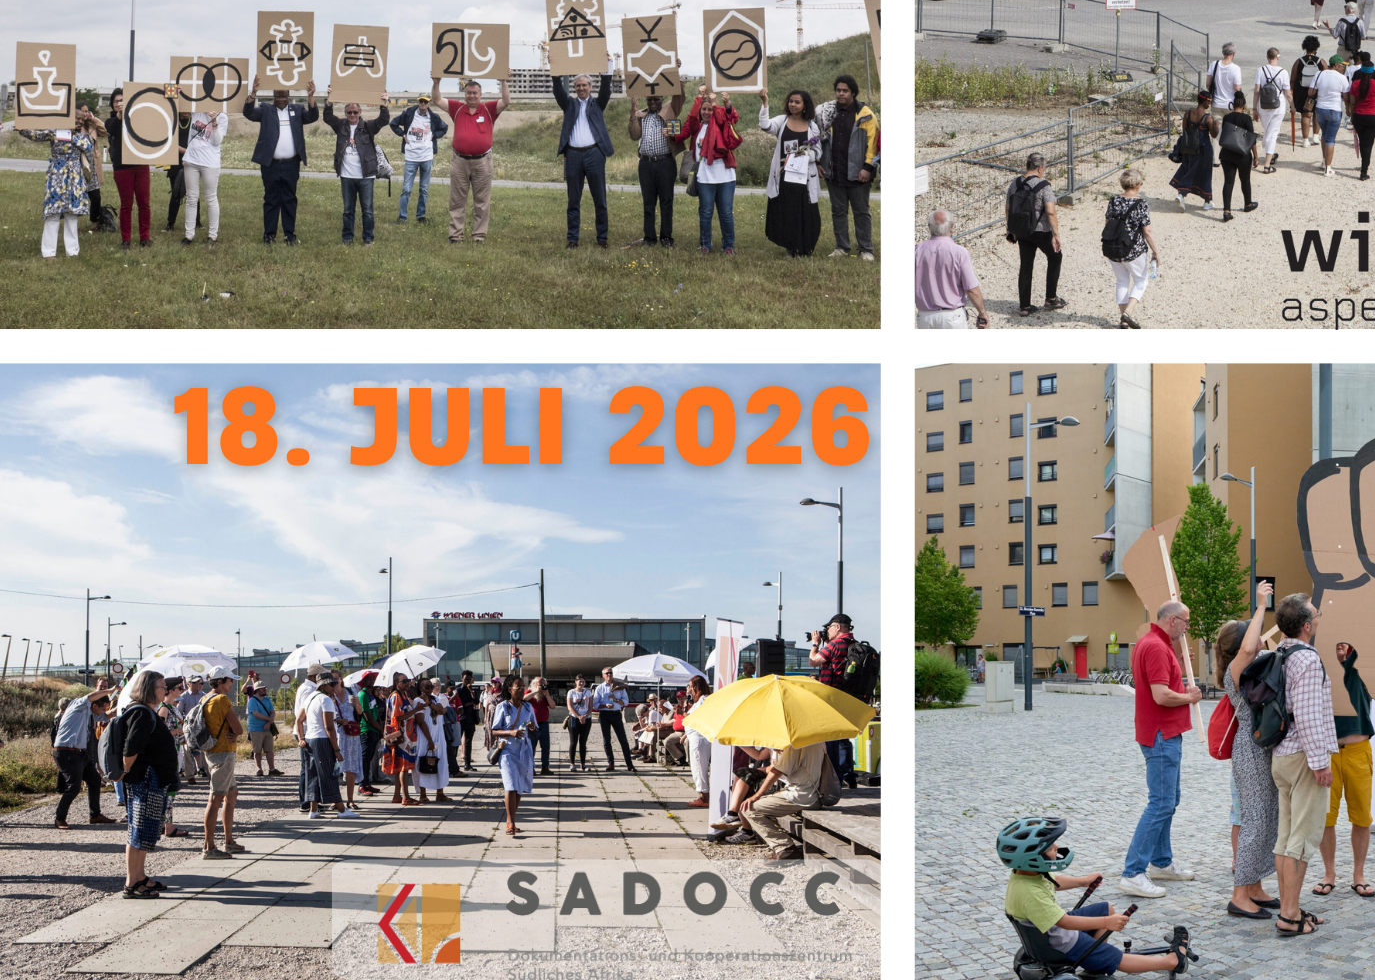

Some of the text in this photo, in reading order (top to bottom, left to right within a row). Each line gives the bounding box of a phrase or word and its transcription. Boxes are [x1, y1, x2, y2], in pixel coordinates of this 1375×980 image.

[443, 611, 503, 619] WIENER LINIEN
[512, 632, 520, 640] U
